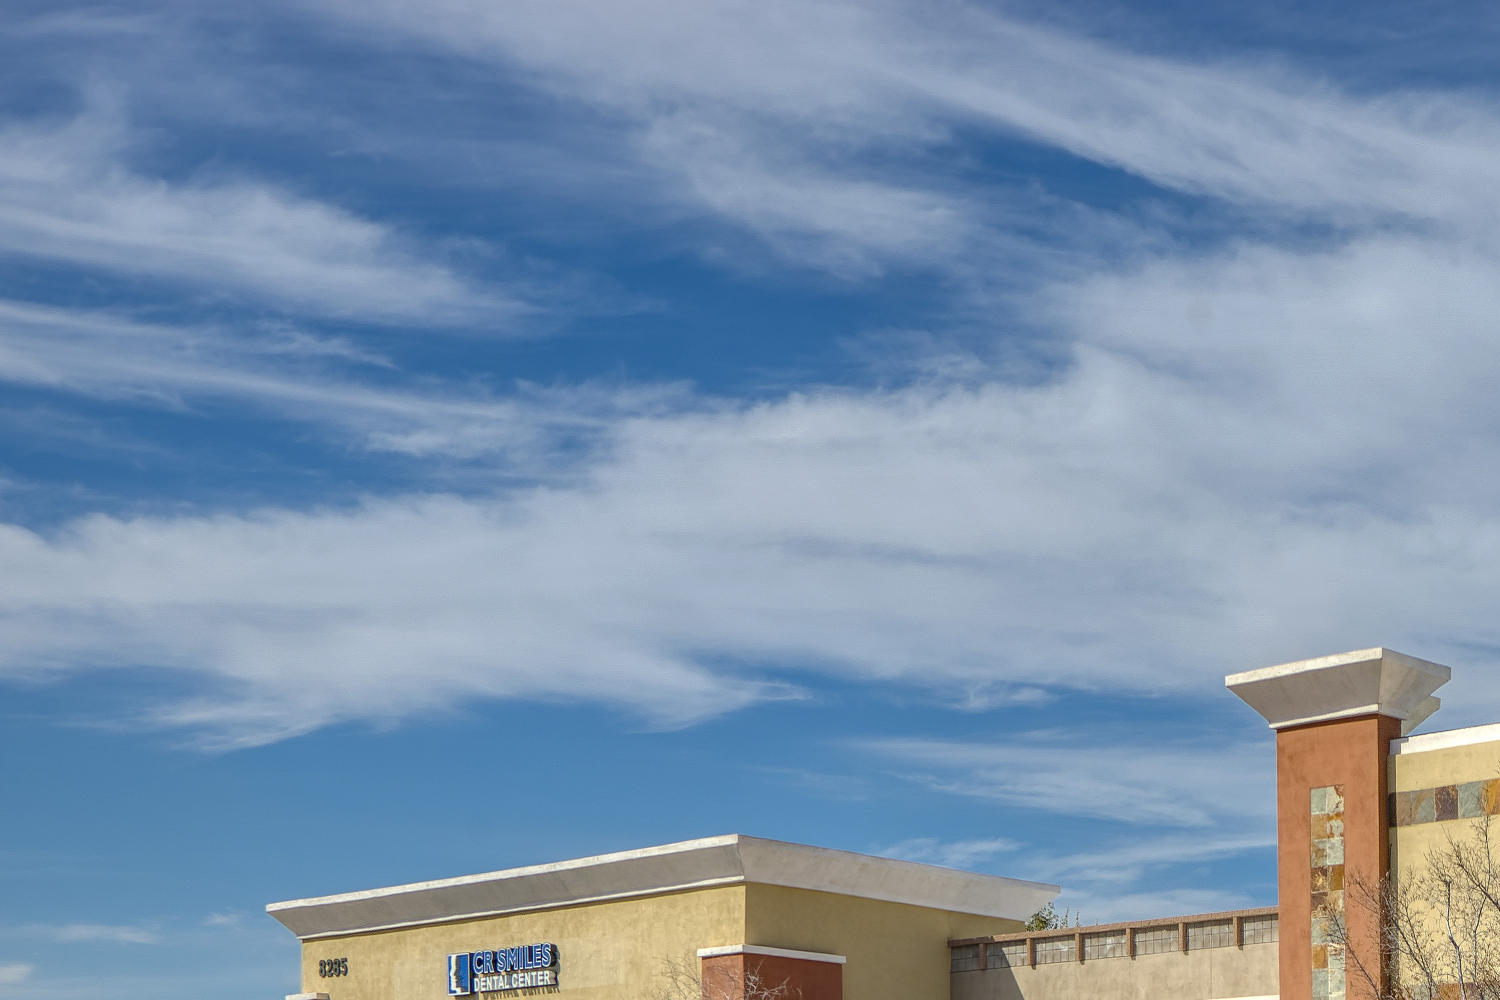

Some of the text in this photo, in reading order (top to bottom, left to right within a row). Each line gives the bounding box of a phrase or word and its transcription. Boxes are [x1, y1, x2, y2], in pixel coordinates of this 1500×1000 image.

[472, 942, 552, 975] CR SMILES
[473, 970, 551, 993] DENTAL CENTER
